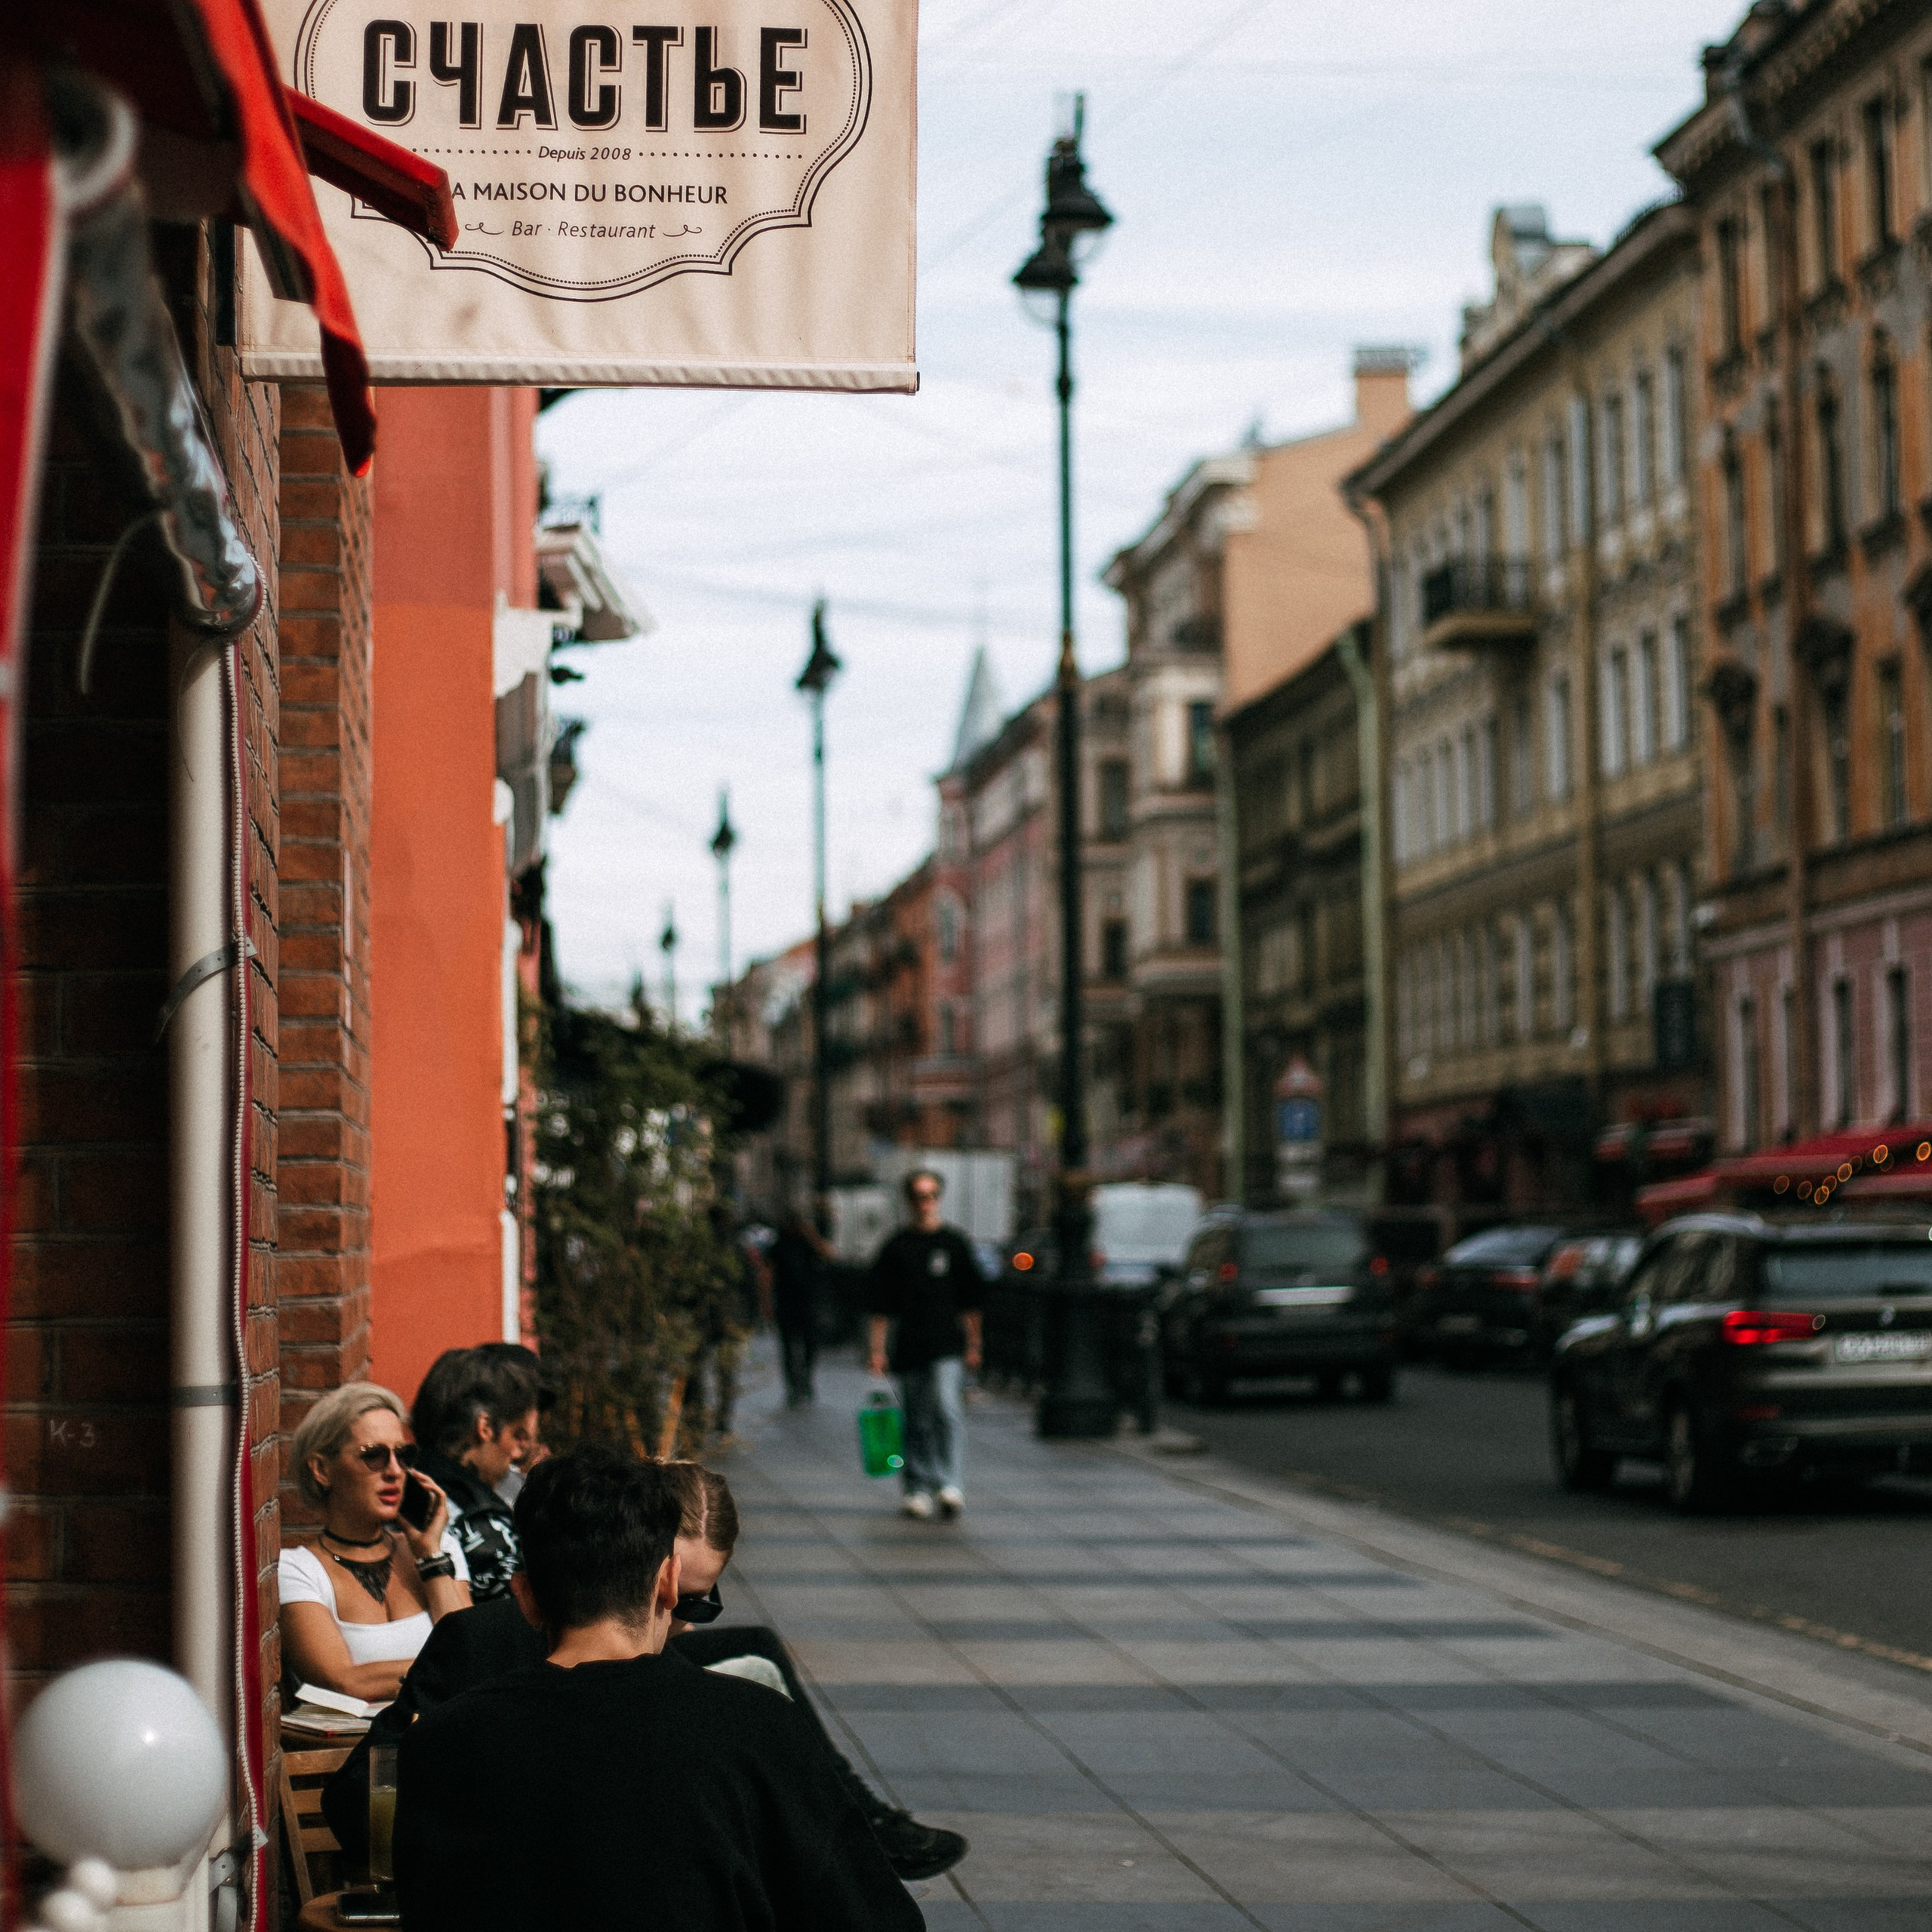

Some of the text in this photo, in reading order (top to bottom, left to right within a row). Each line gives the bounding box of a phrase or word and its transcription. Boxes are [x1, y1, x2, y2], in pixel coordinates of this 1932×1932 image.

[362, 19, 808, 135] СЧАСТЬЕ
[538, 146, 632, 162] Depuis 2008
[452, 182, 728, 205] A MAISON DU BONHEUR
[512, 220, 657, 238] Bar Restaurant
